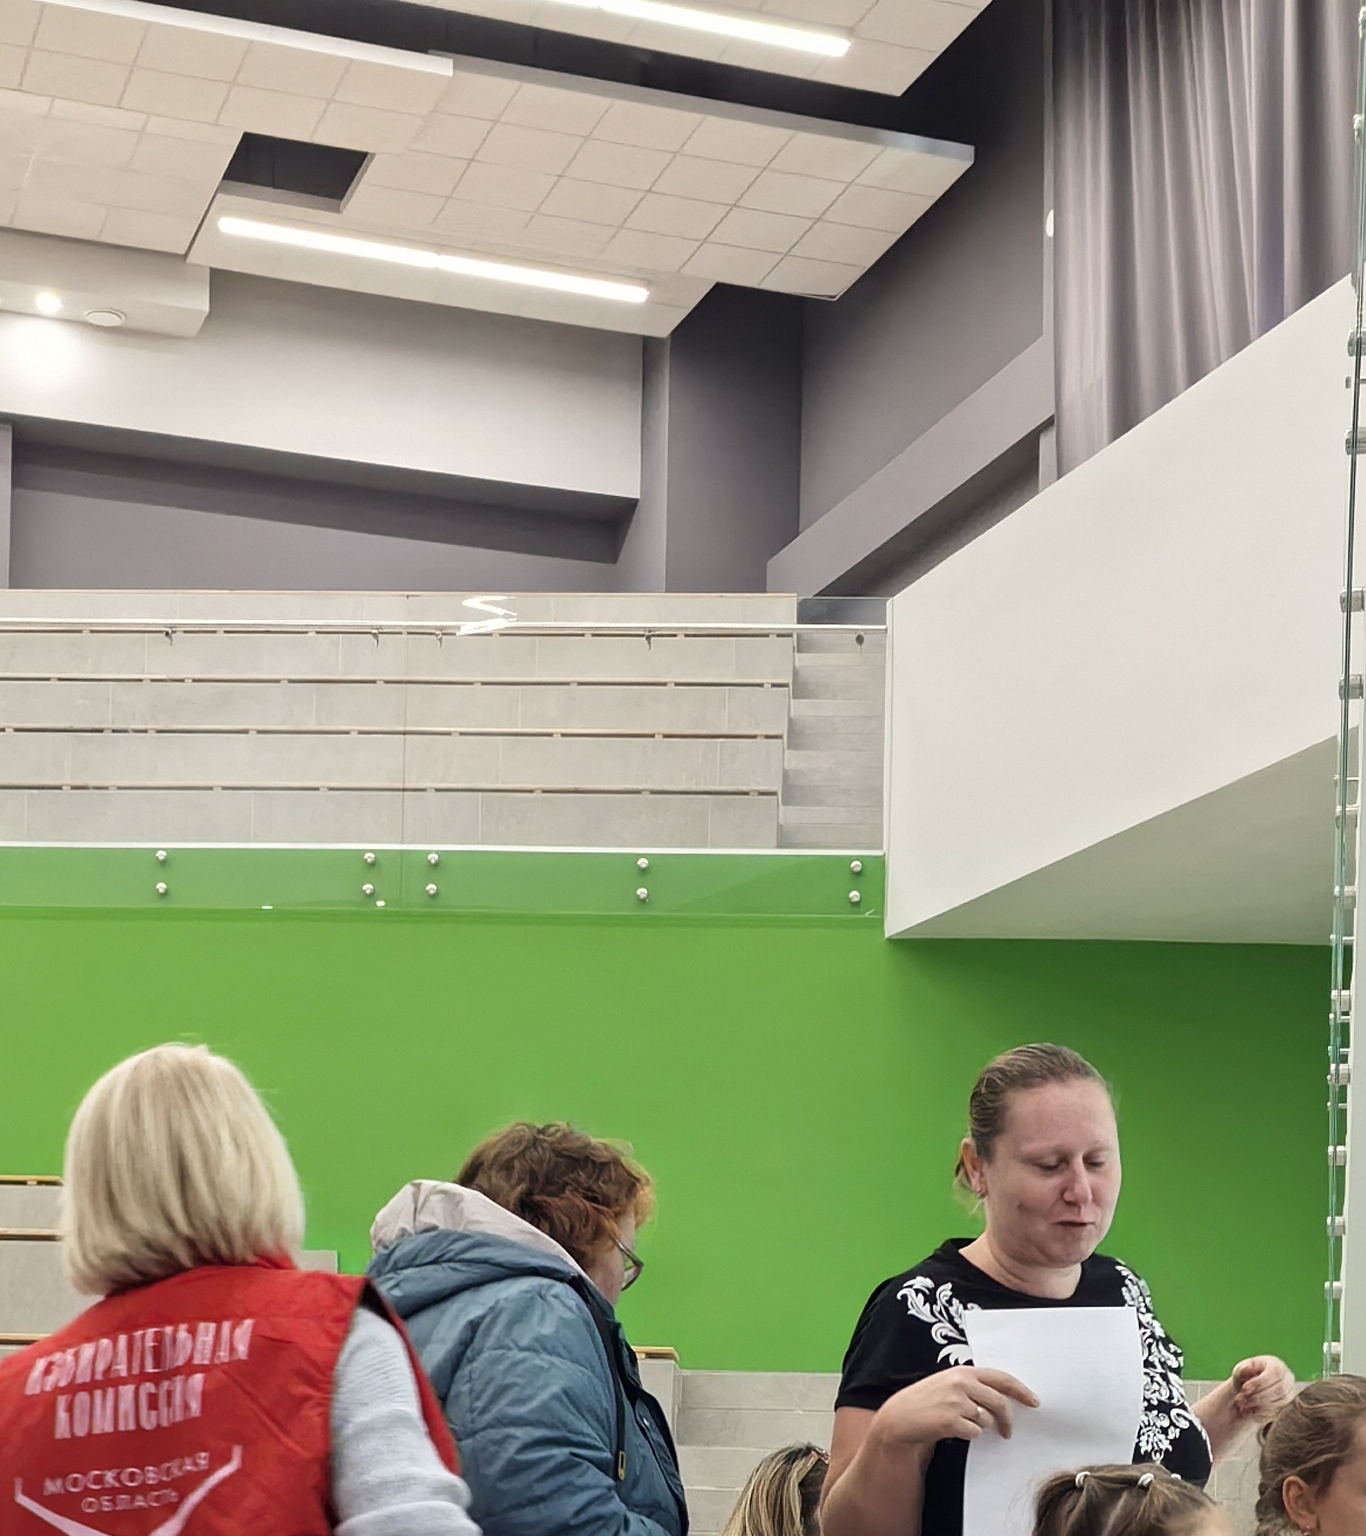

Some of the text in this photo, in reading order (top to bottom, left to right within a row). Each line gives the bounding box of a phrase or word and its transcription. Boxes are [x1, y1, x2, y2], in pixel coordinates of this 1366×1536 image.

[24, 1318, 256, 1395] ИЗБИРАТЕЛЬНАЯ
[54, 1373, 206, 1440] КОМИССИЯ
[42, 1451, 210, 1496] МОСКОВСКАЯ
[80, 1488, 180, 1514] ОБЛАСТЬ
